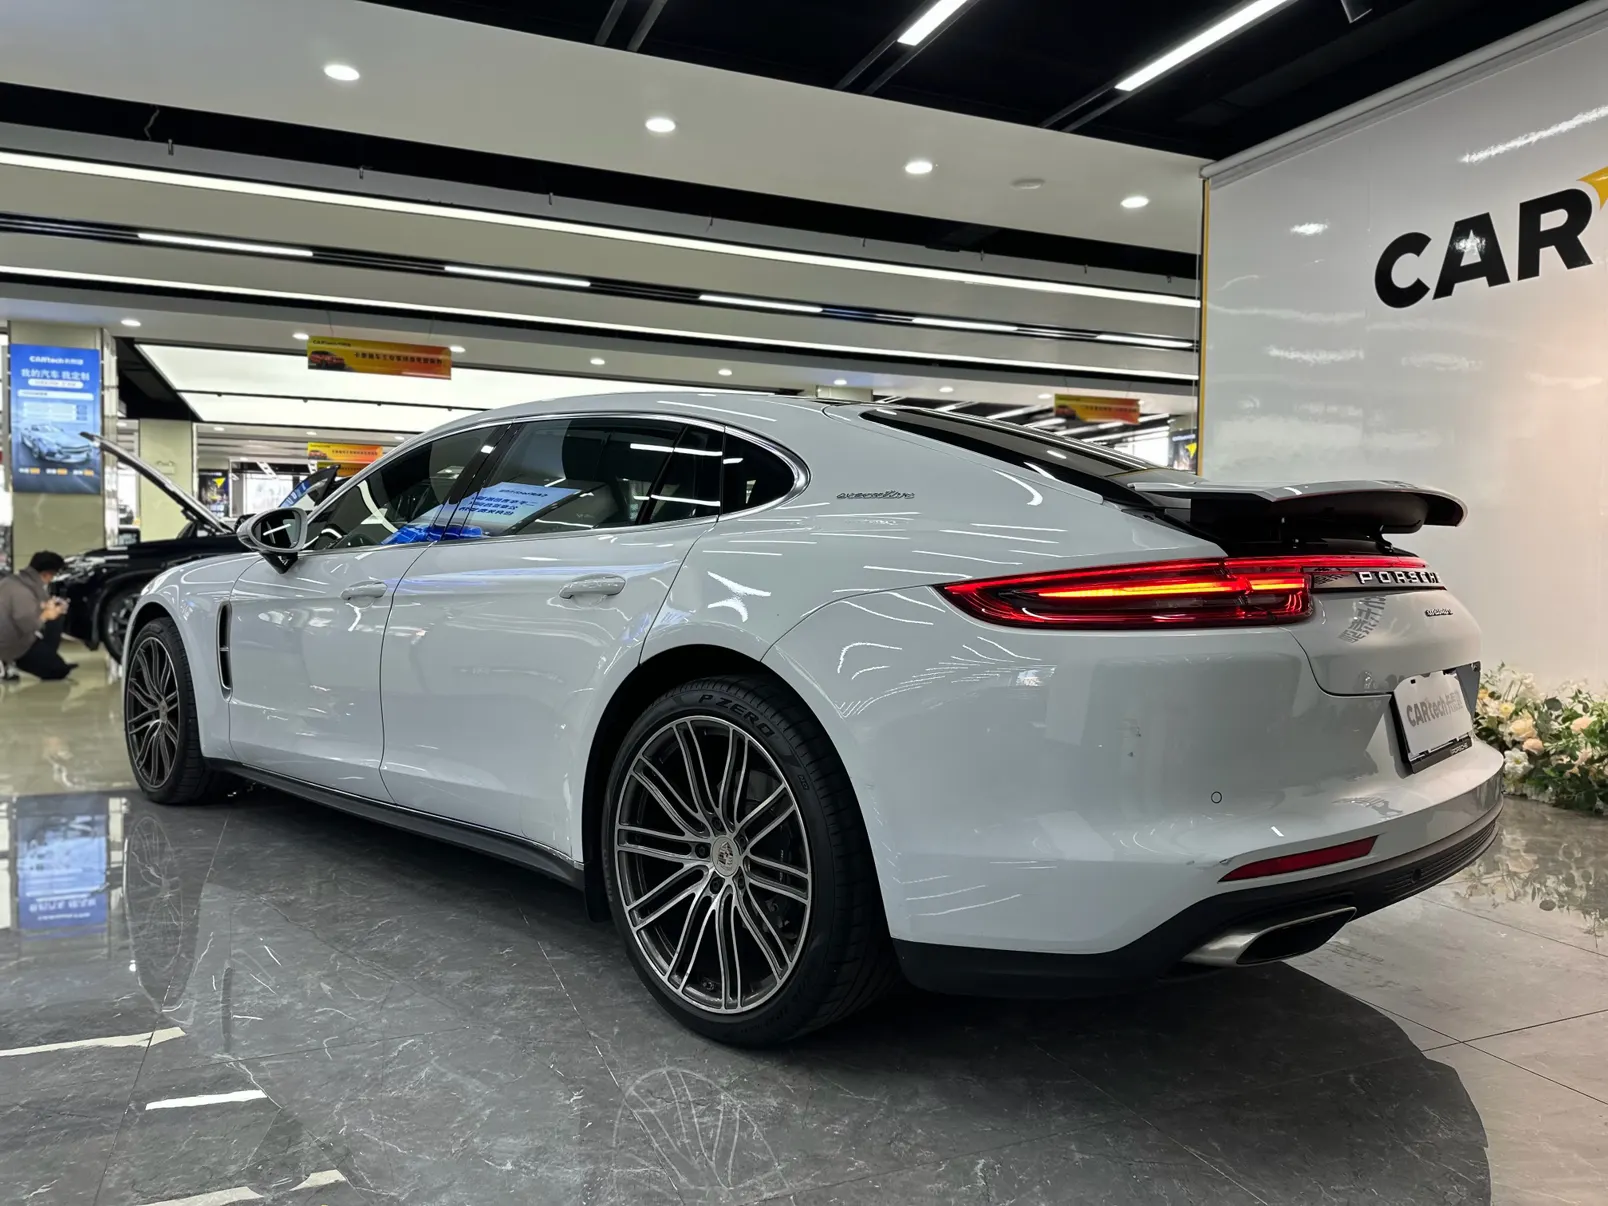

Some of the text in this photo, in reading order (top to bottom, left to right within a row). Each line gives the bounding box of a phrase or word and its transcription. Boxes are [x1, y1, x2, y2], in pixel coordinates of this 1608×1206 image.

[1375, 188, 1594, 308] CAR
[698, 694, 776, 738] P ZERO
